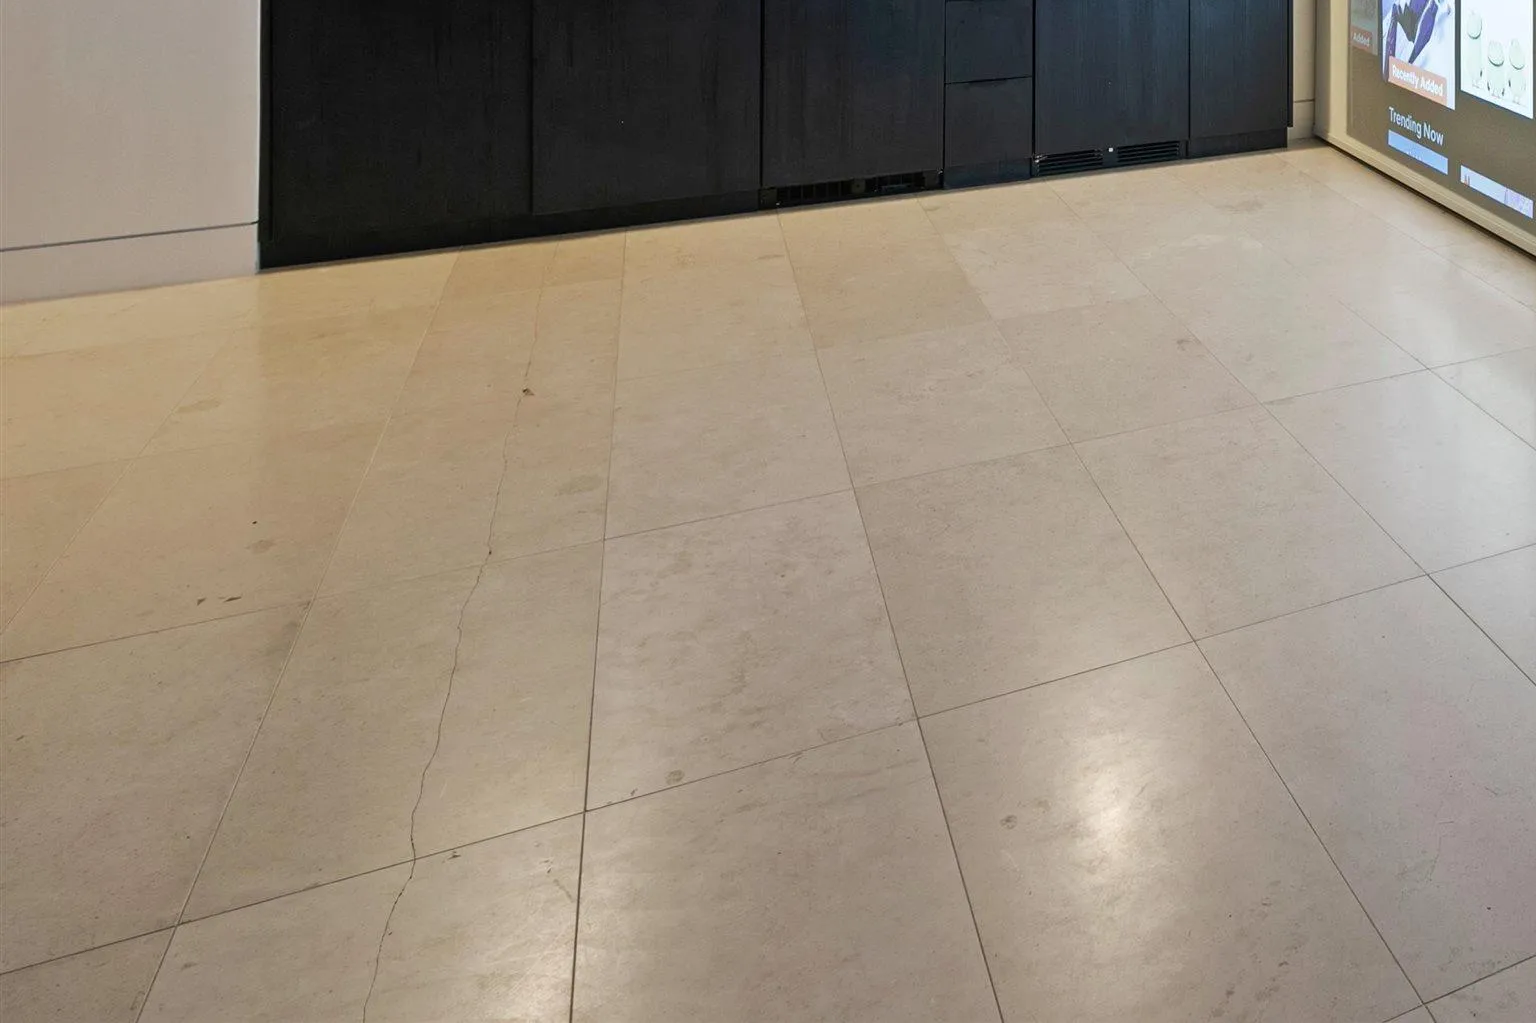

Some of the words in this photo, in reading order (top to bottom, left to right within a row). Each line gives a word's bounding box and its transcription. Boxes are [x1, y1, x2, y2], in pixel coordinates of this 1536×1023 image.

[1392, 64, 1419, 88] Recently
[1420, 76, 1443, 96] Added
[1389, 106, 1422, 139] Trending
[1423, 122, 1444, 147] Now
